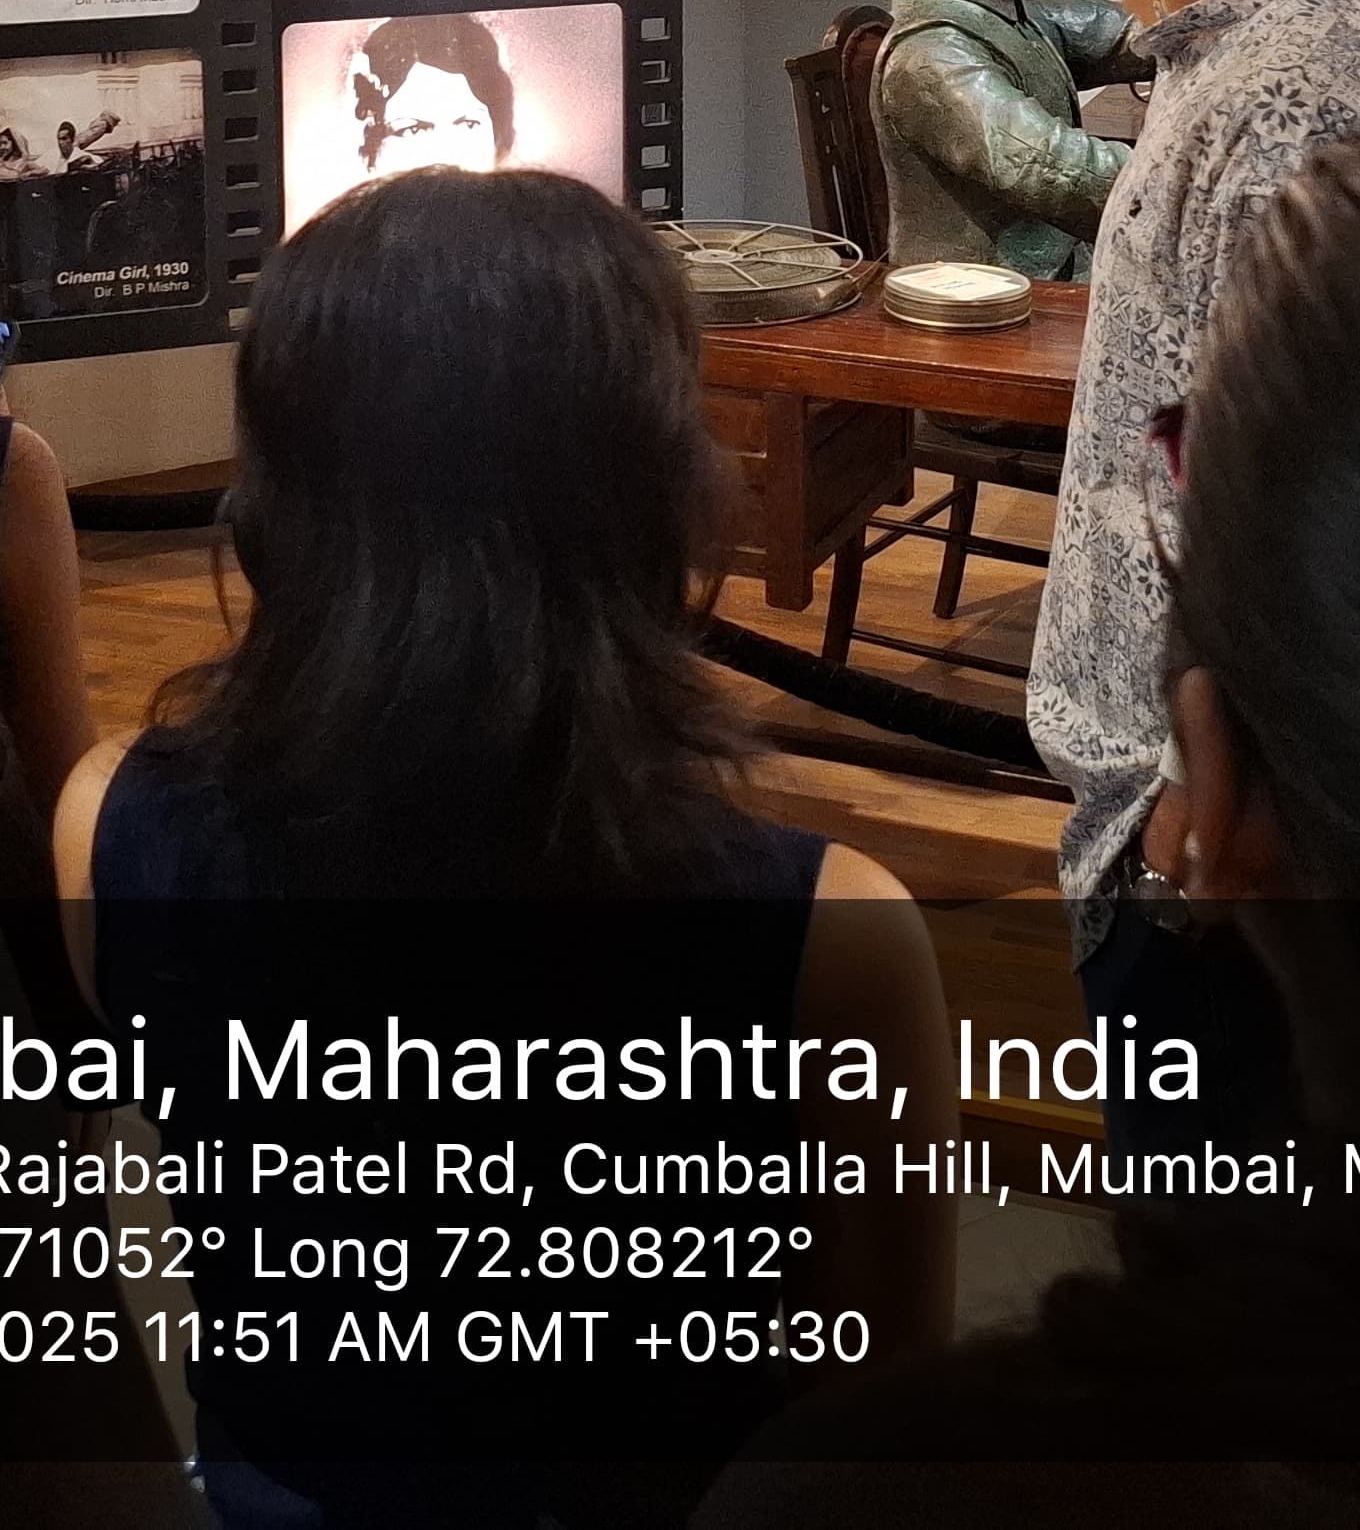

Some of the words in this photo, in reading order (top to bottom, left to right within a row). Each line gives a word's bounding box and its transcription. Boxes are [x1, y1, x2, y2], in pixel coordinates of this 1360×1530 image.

[56, 270, 115, 285] Cinema
[119, 265, 150, 280] Girl,
[153, 261, 190, 277] 1930
[94, 286, 116, 299] Dir.
[123, 284, 133, 296] B
[136, 283, 145, 294] P
[148, 280, 190, 293] Mishra
